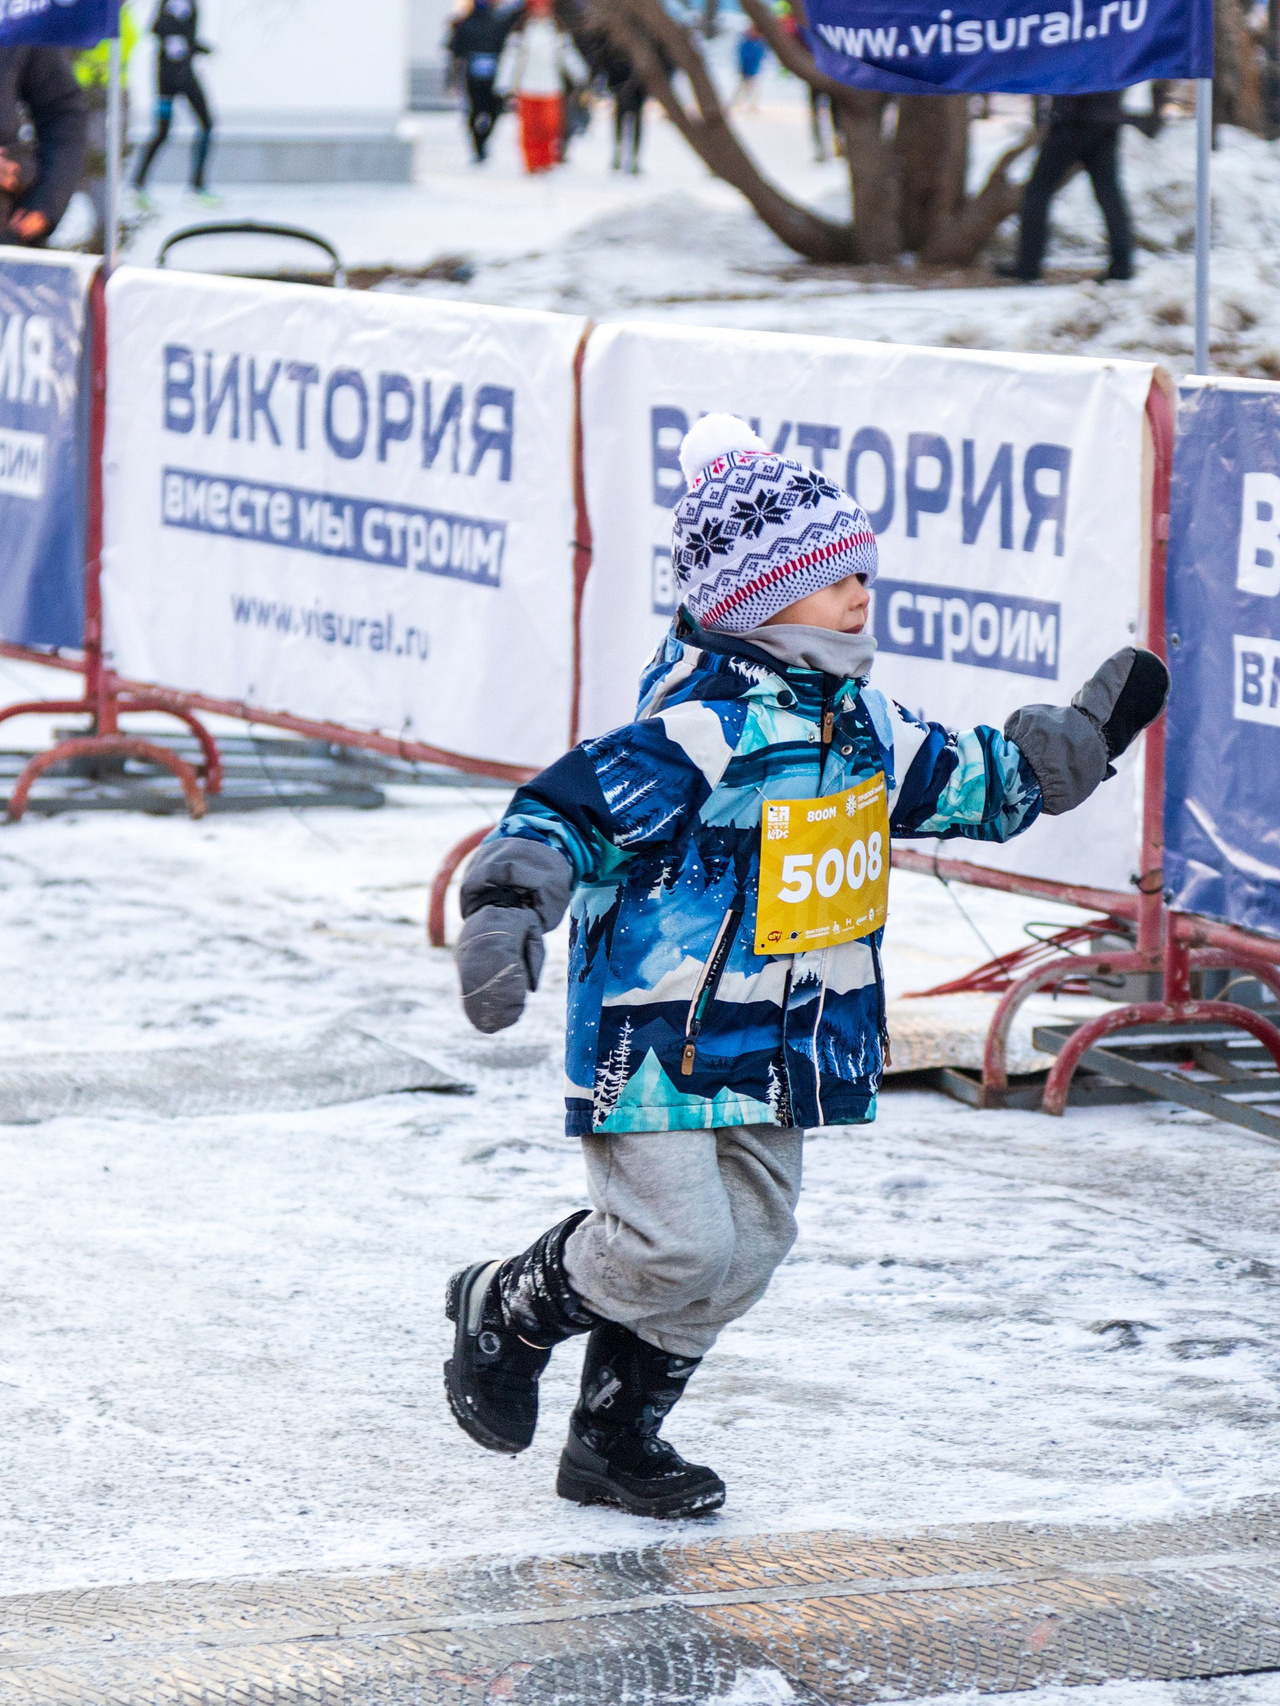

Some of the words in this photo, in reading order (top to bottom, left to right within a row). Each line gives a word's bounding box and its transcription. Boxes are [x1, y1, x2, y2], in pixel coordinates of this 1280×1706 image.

[817, 0, 1147, 57] www.visural.ru
[164, 344, 515, 481] ВИКТОРИЯ
[300, 498, 353, 548] мы
[363, 508, 501, 577] строим
[231, 594, 429, 660] www.visural.ru
[888, 589, 1057, 667] строим
[777, 831, 883, 904] 5008
